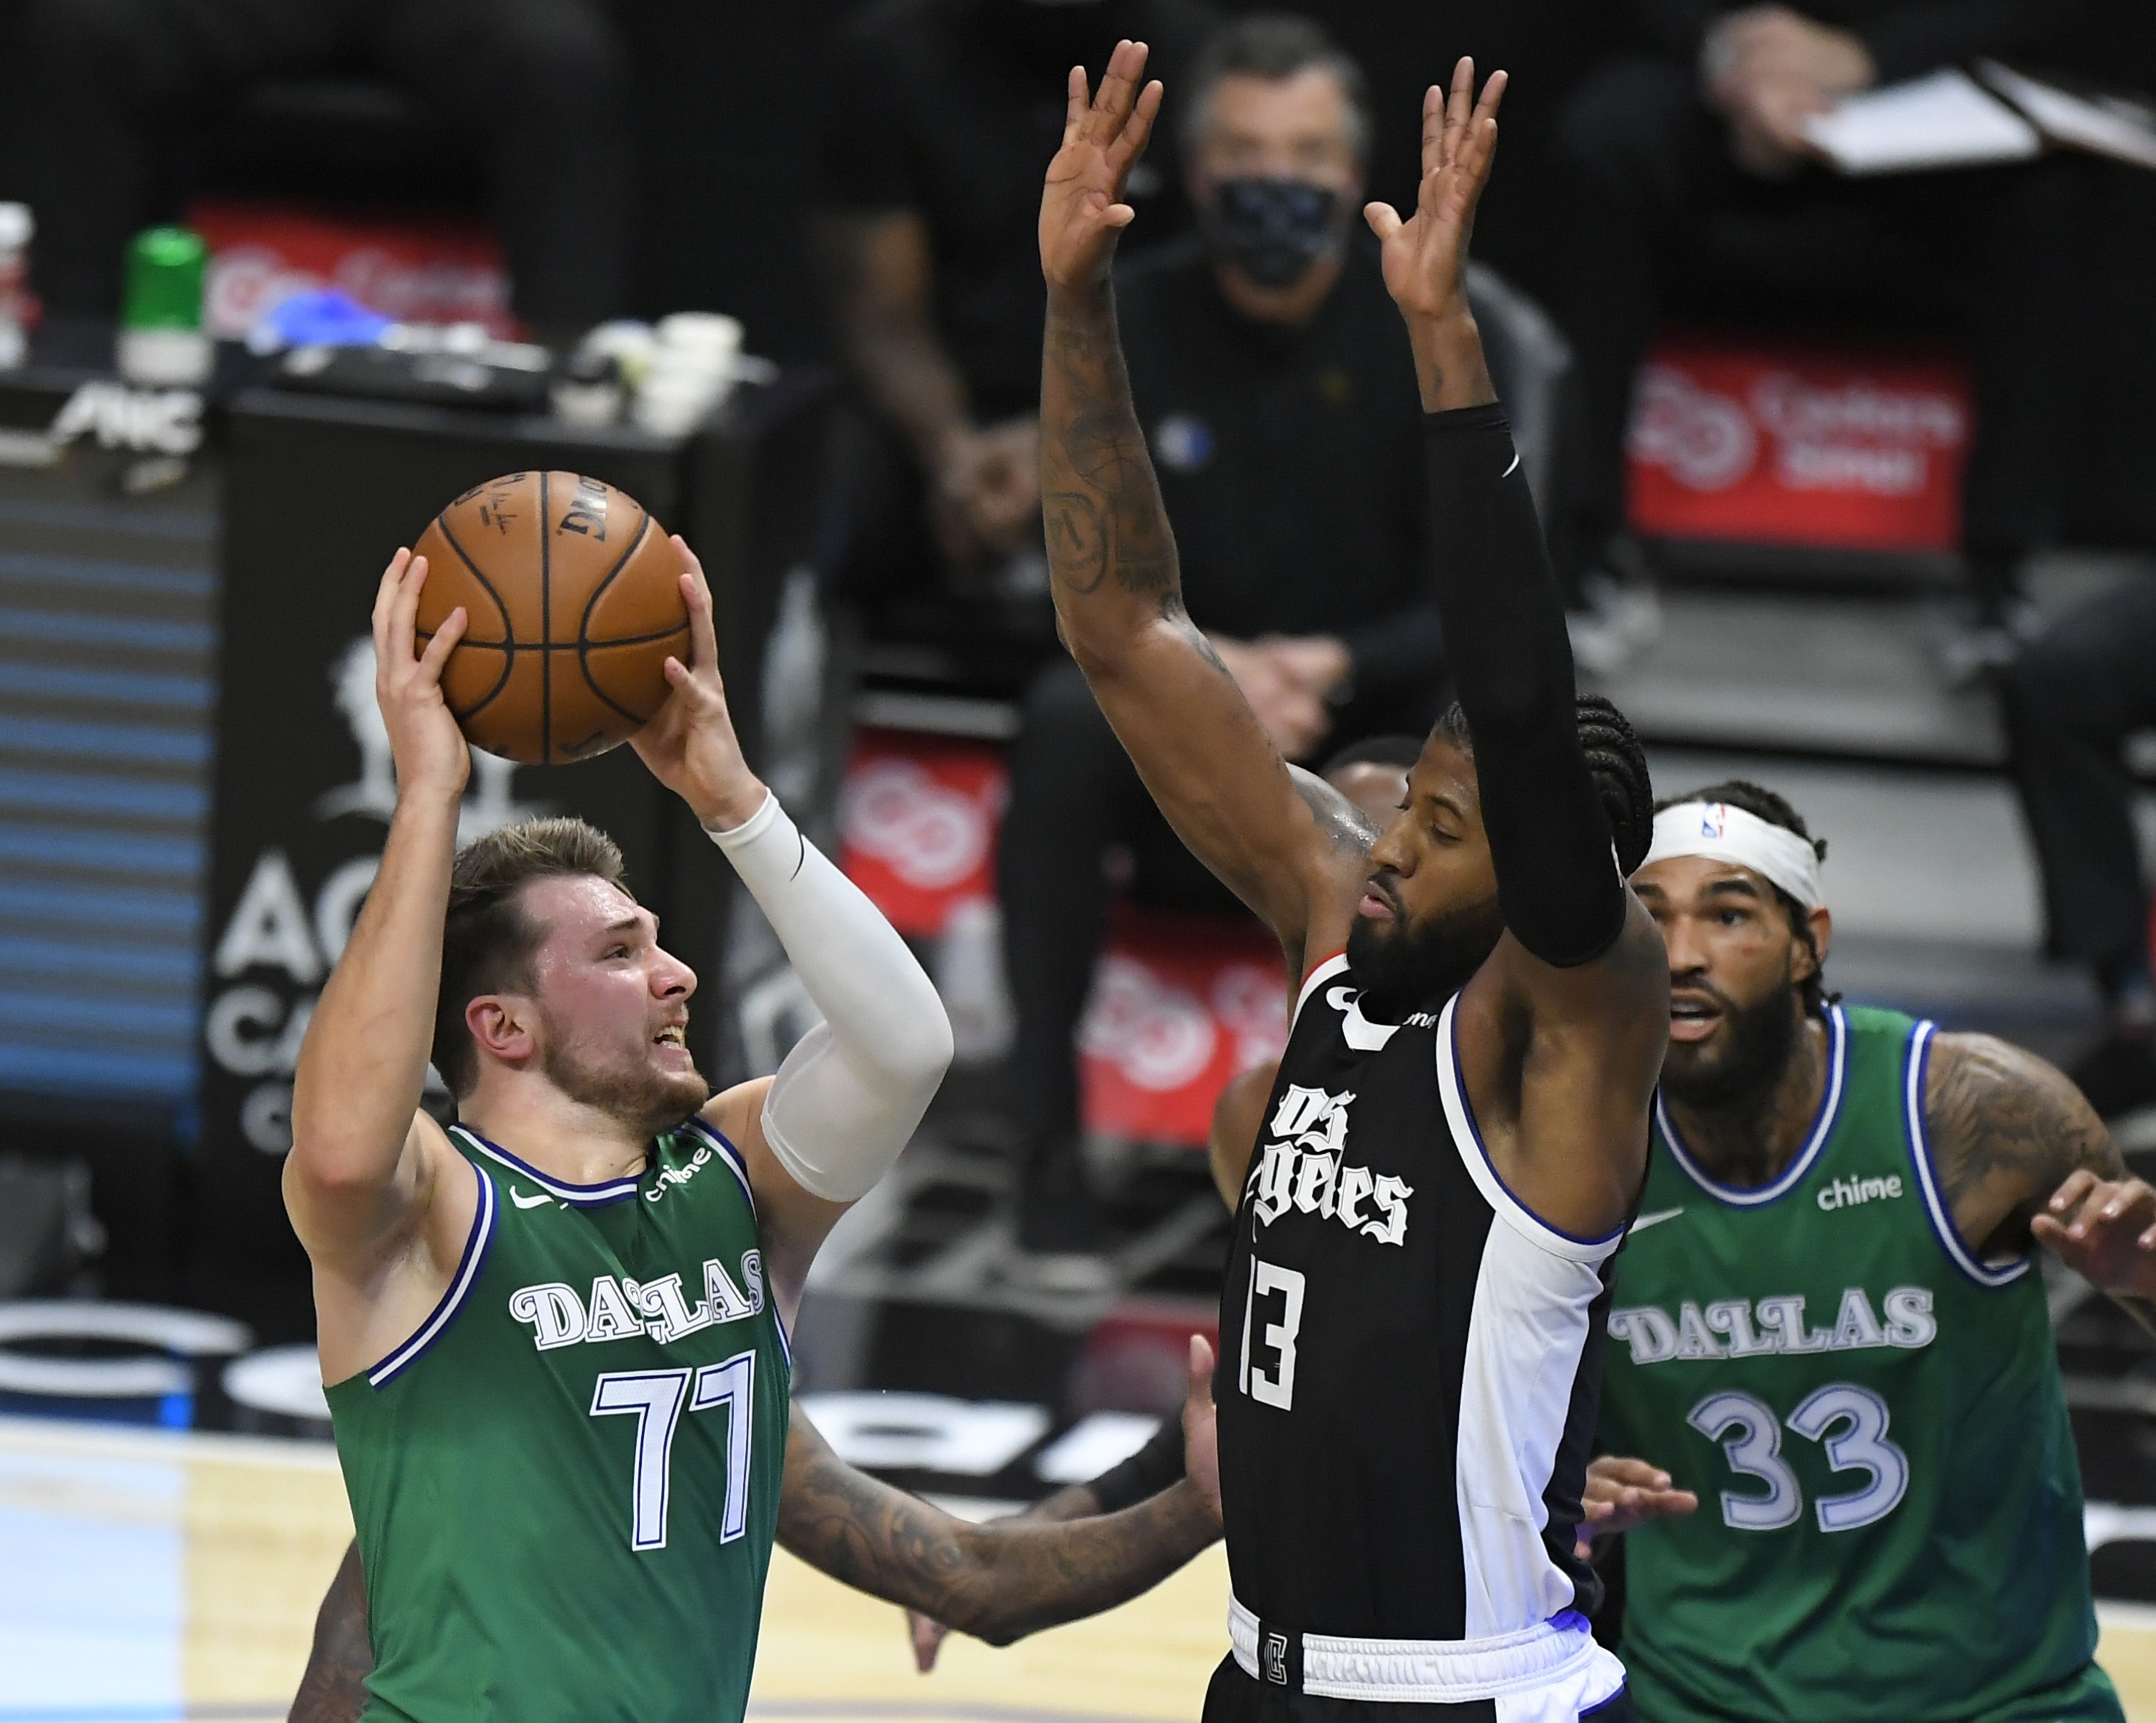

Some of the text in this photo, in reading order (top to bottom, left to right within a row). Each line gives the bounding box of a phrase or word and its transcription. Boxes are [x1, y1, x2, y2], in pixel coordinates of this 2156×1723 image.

[1817, 1173, 1903, 1211] chime
[1607, 1288, 1938, 1365] DALLAS
[589, 1349, 756, 1552] 77
[1686, 1384, 1910, 1533] 33
